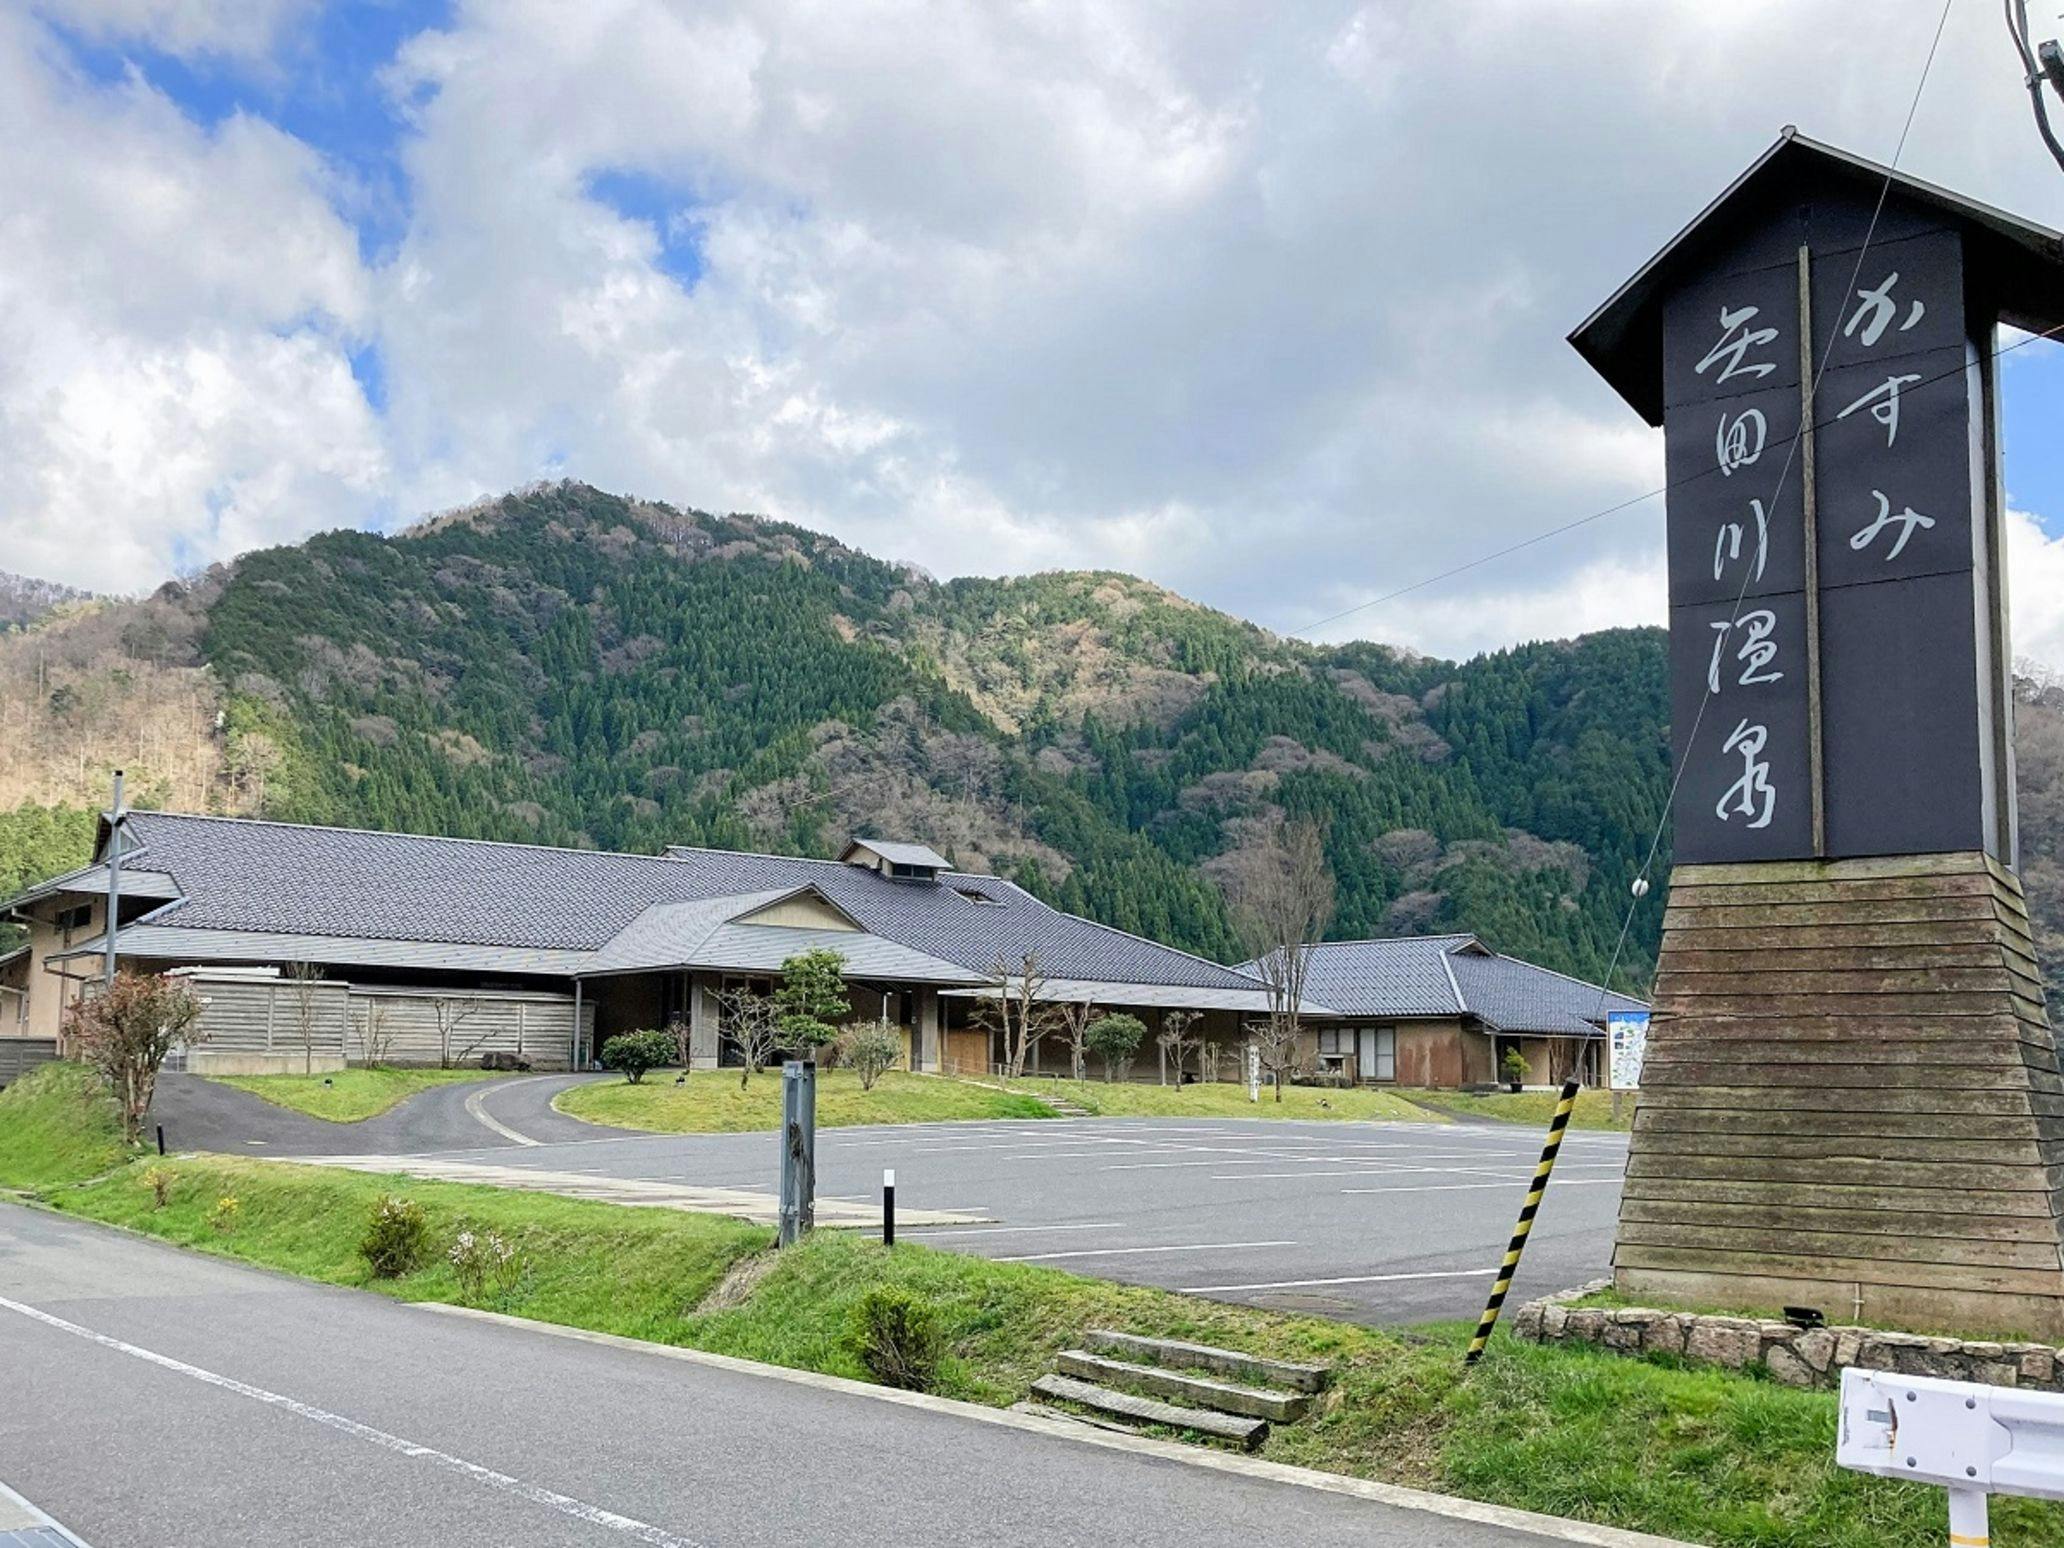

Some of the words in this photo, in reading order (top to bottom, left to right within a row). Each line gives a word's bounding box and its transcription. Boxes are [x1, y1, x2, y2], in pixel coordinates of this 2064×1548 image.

[1694, 305, 1784, 829] 矢田川温泉
[1836, 271, 1935, 561] かすみ
